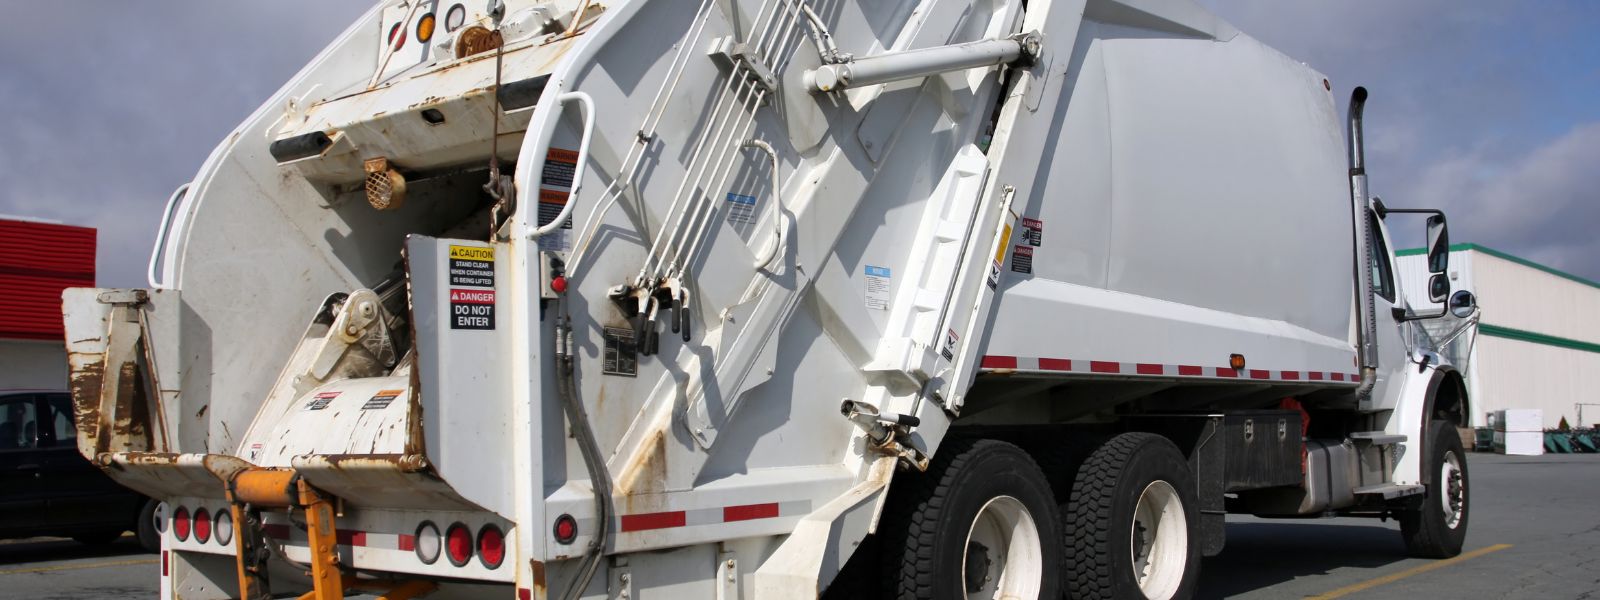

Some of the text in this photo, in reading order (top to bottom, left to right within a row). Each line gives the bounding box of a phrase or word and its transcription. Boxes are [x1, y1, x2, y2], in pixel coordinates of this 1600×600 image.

[459, 249, 493, 258] CAUTION
[460, 292, 494, 301] DANGER
[455, 305, 491, 315] DO NOT
[458, 316, 488, 326] ENTER
